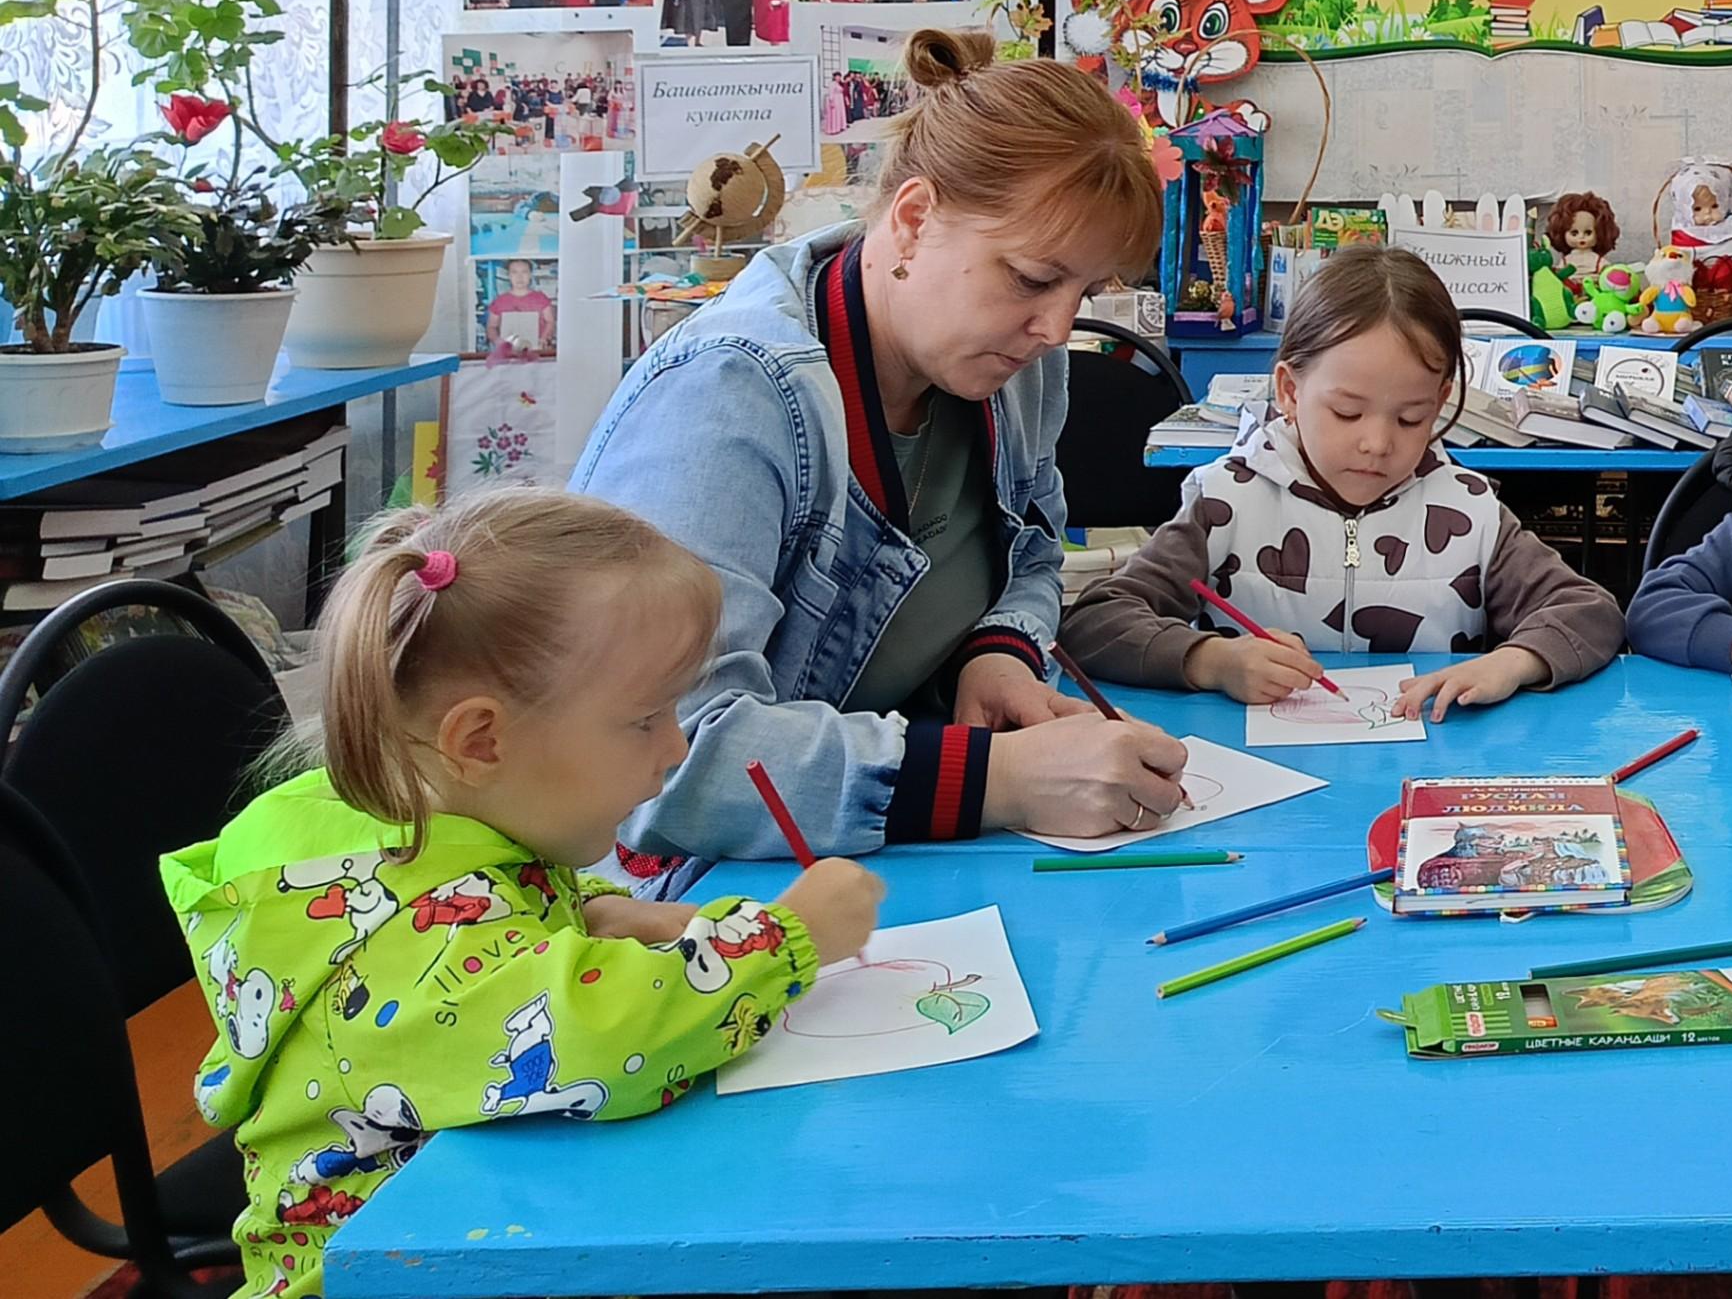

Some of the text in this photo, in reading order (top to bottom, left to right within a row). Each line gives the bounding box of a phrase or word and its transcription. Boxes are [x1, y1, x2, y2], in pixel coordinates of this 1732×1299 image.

[652, 81, 804, 99] Башваткычта
[686, 108, 772, 127] кунакта
[1461, 792, 1567, 800] РУСЛАН
[1442, 804, 1585, 813] ЛЮДМИЛА
[1525, 1036, 1584, 1049] ЦВЕТНЫЕ
[1588, 1034, 1672, 1046] КАРАНДАШИ
[1681, 1032, 1696, 1043] 12
